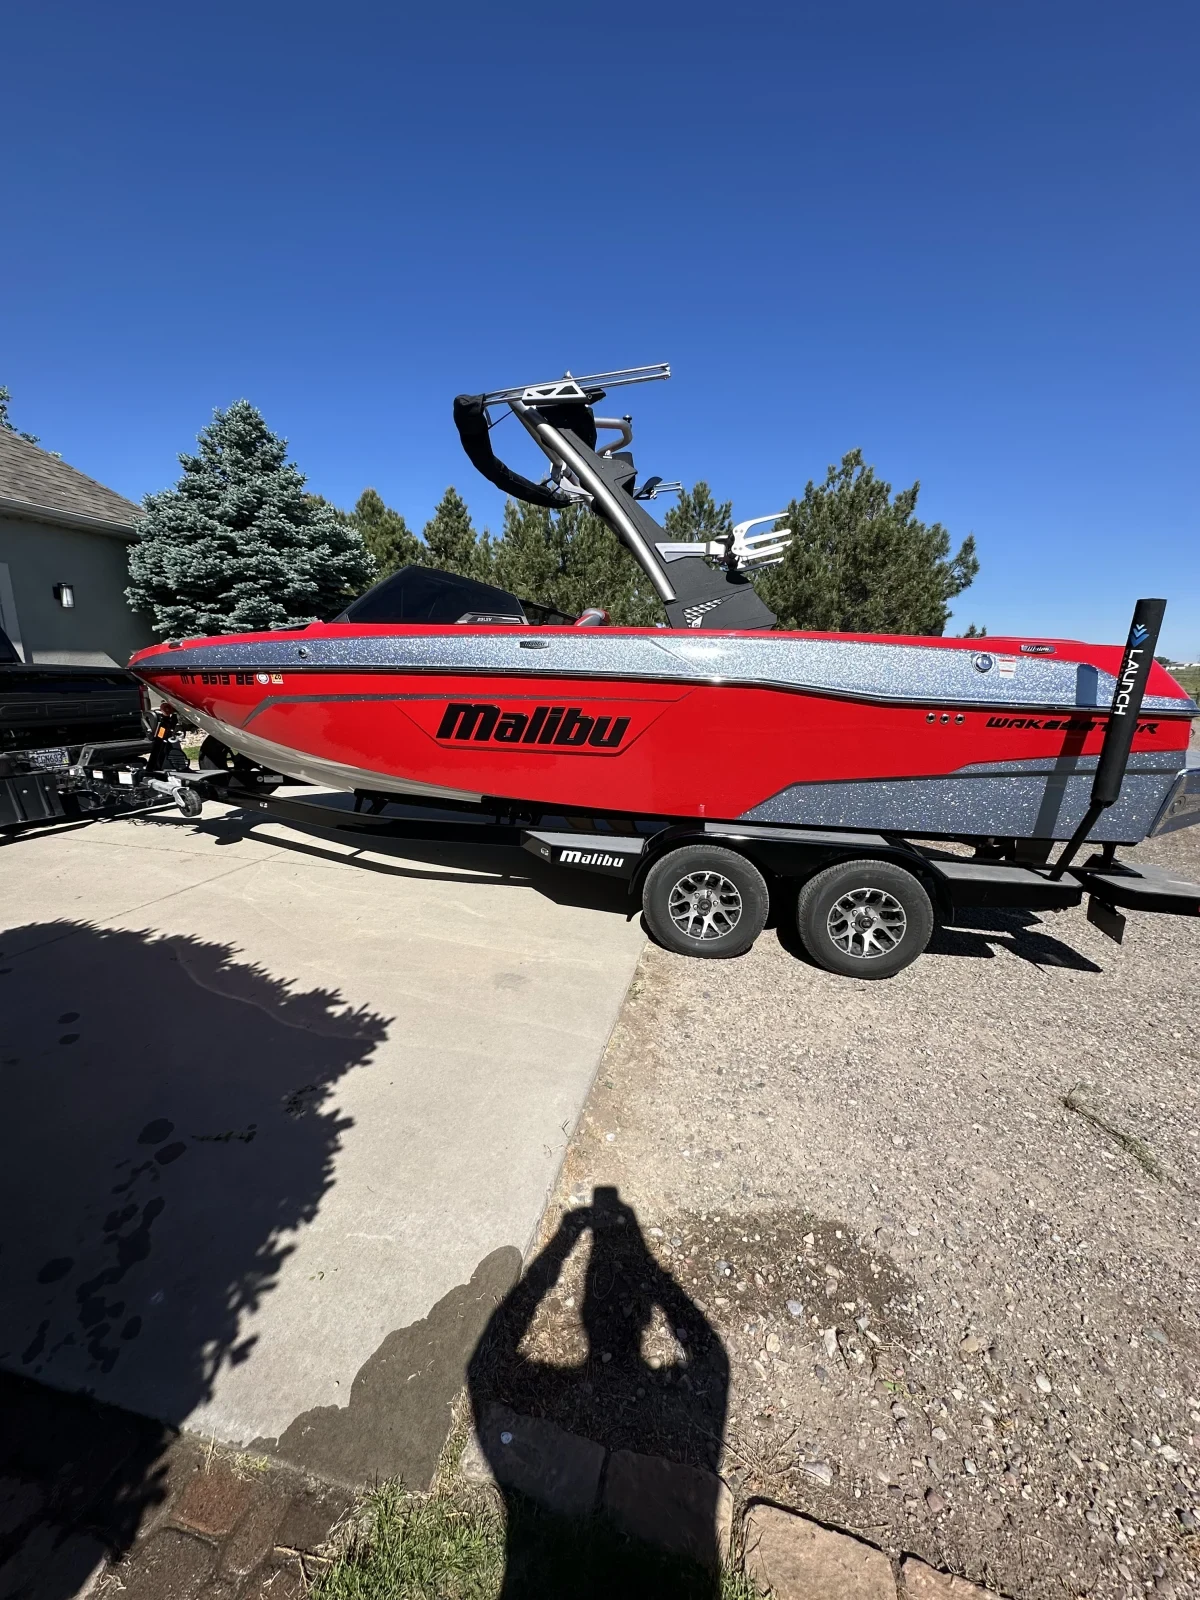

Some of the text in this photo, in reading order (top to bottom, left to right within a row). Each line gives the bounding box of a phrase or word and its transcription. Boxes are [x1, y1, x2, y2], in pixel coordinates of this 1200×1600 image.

[1114, 649, 1144, 715] LAUNCH
[436, 702, 632, 748] Malibu
[985, 715, 1160, 735] WAKESETR
[559, 849, 625, 868] Malibu
